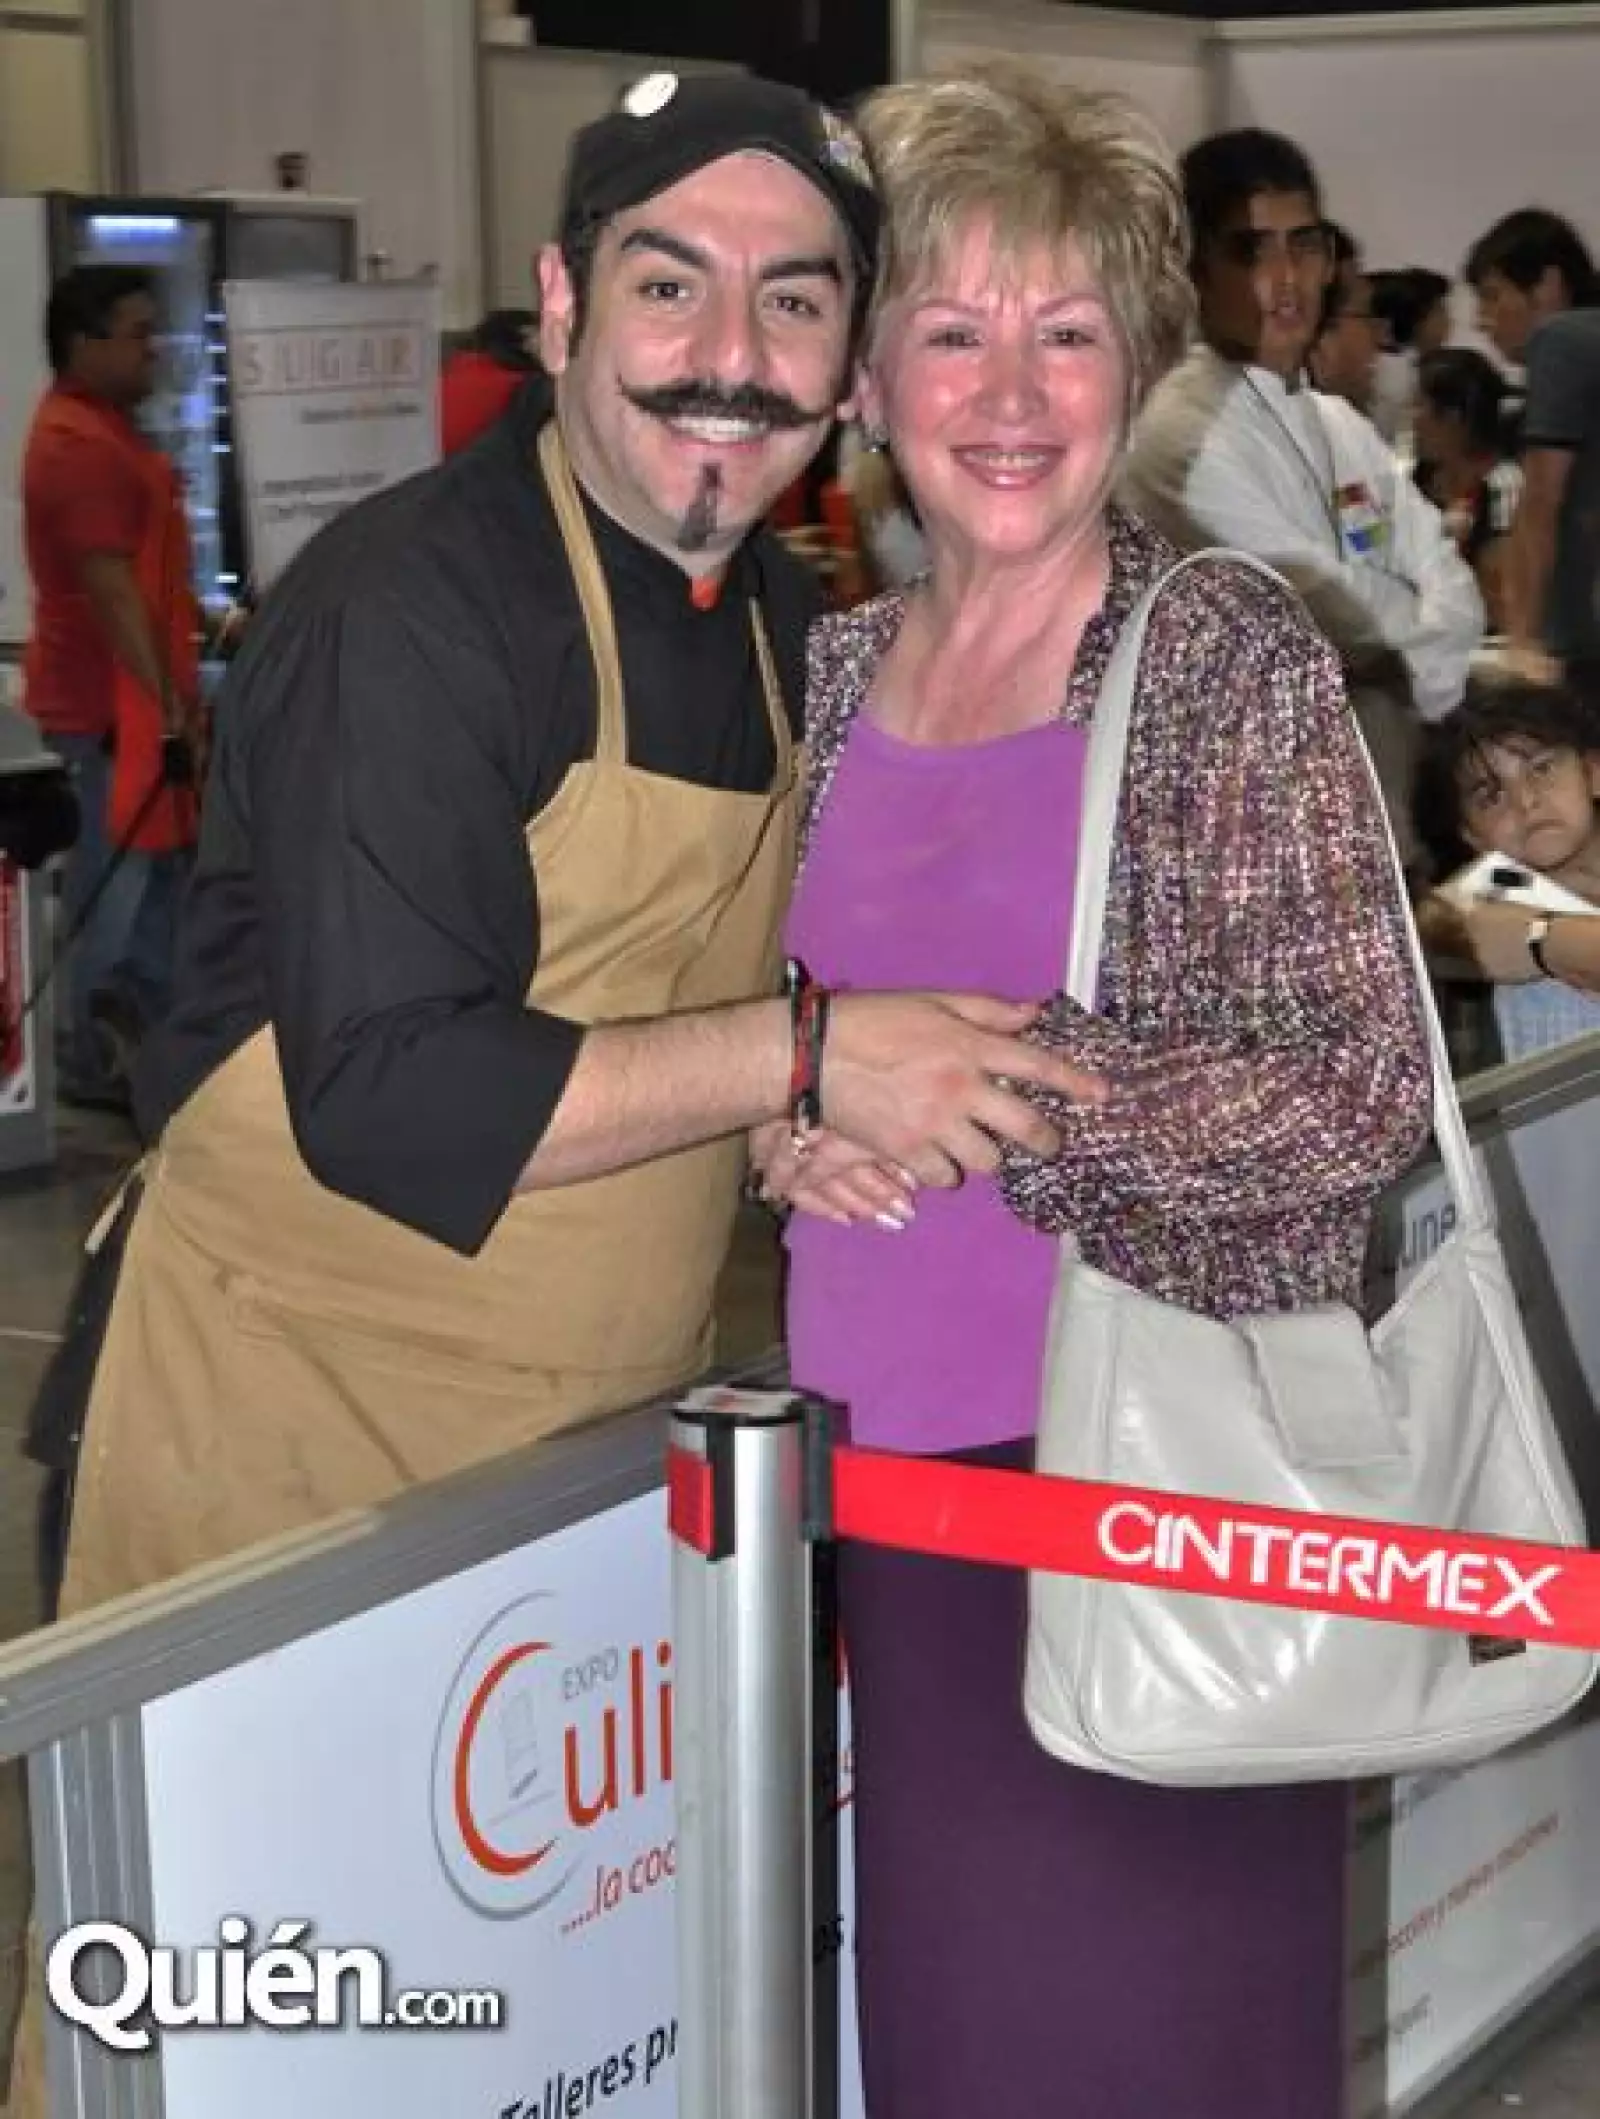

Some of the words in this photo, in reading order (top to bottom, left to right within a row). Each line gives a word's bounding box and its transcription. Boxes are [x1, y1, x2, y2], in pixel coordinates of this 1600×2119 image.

[238, 333, 413, 386] SUGAR
[1098, 1500, 1564, 1626] CINTERMEX
[562, 1647, 619, 1699] EXPO
[499, 2040, 637, 2119] lleres
